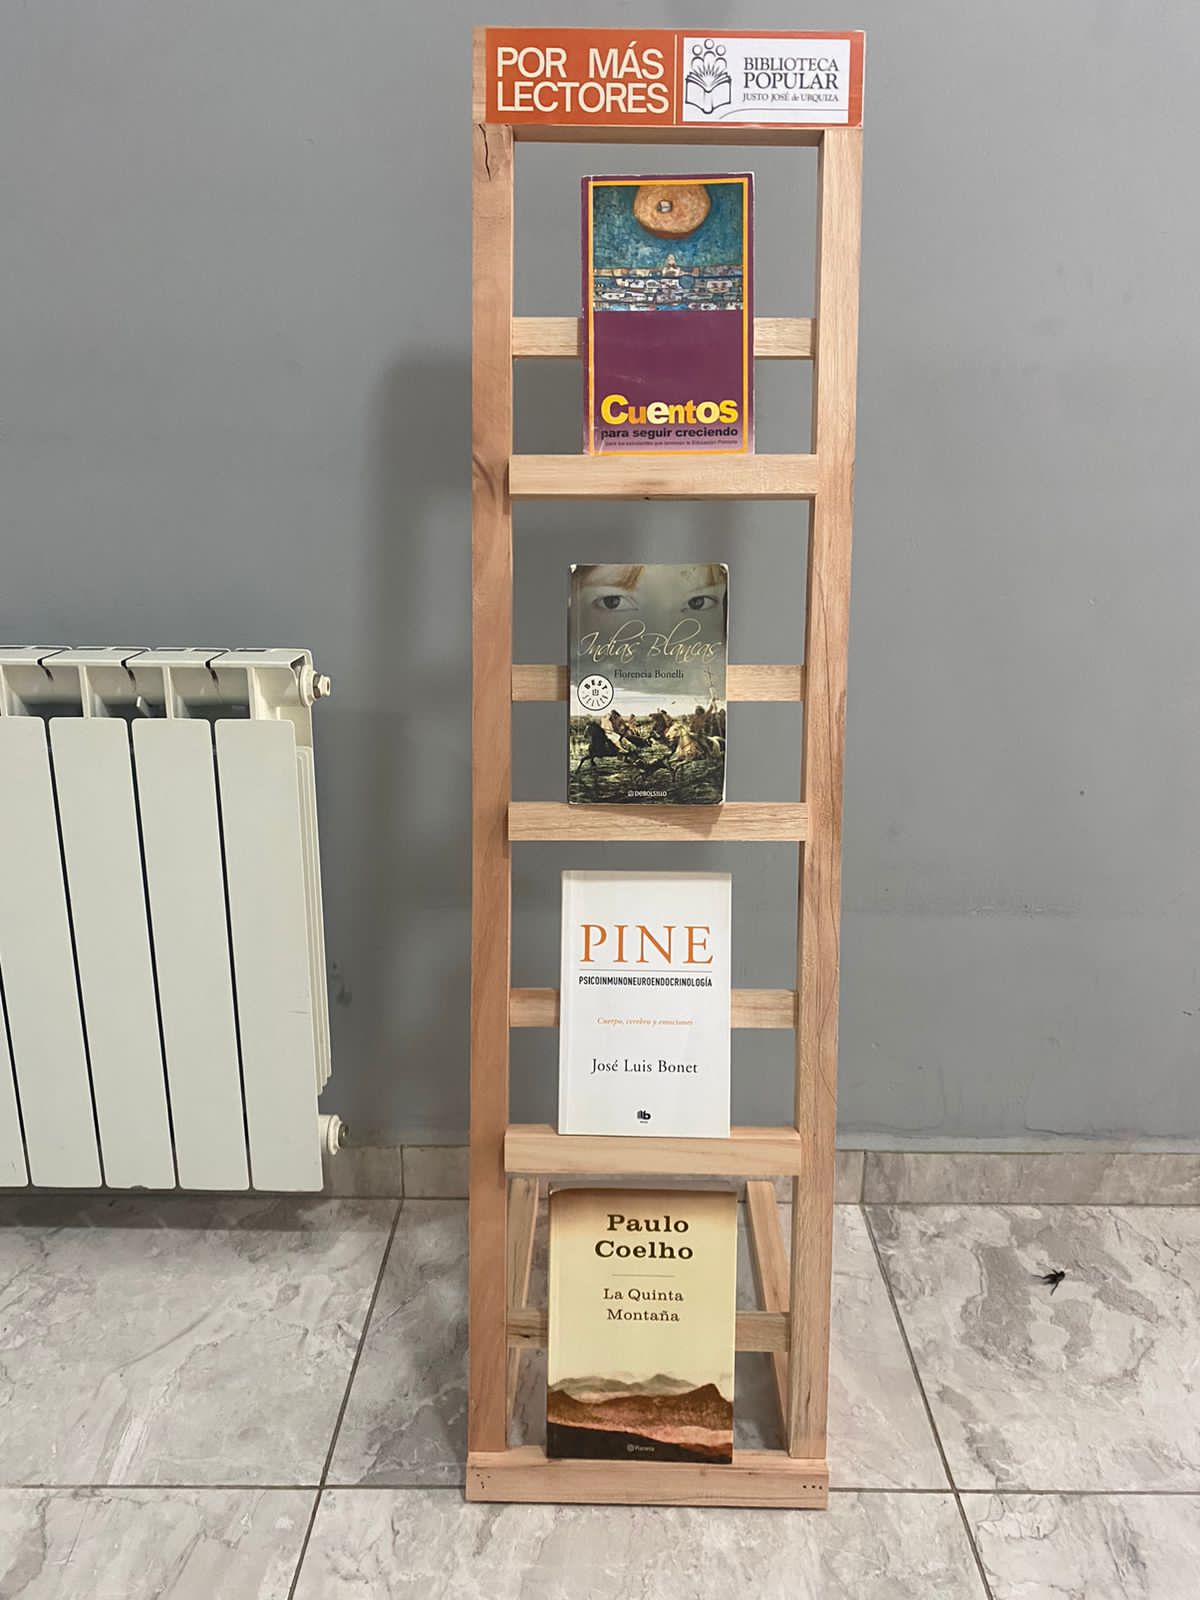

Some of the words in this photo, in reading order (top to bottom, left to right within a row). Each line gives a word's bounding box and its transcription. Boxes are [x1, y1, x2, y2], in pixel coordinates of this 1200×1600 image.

[497, 47, 567, 78] POR
[589, 41, 664, 79] MÁS
[744, 57, 839, 72] BIBLIOTECA
[744, 72, 839, 89] POPULAR
[497, 81, 669, 114] LECTORES
[742, 93, 769, 102] JUSTO
[771, 91, 788, 102] JOSÉ
[801, 93, 839, 103] URQUIZA
[601, 394, 738, 425] Cuentos
[601, 430, 629, 440] para
[633, 428, 672, 439] seguir
[676, 427, 738, 437] creciendo
[578, 619, 646, 664] Indias
[641, 617, 722, 664] Blancas
[614, 669, 652, 679] Florencia
[655, 669, 684, 679] Bonelli
[579, 924, 714, 964] PINE
[578, 976, 712, 987] PSICOINMUNONEUROENDOCRINOLOGÍA
[591, 1058, 618, 1075] José
[624, 1059, 653, 1073] Luis
[658, 1060, 698, 1074] Bonet
[607, 1214, 689, 1233] Paulo
[595, 1240, 693, 1260] Coelho
[603, 1288, 623, 1300] La
[628, 1289, 684, 1302] Quinta
[607, 1308, 680, 1322] Montaña
